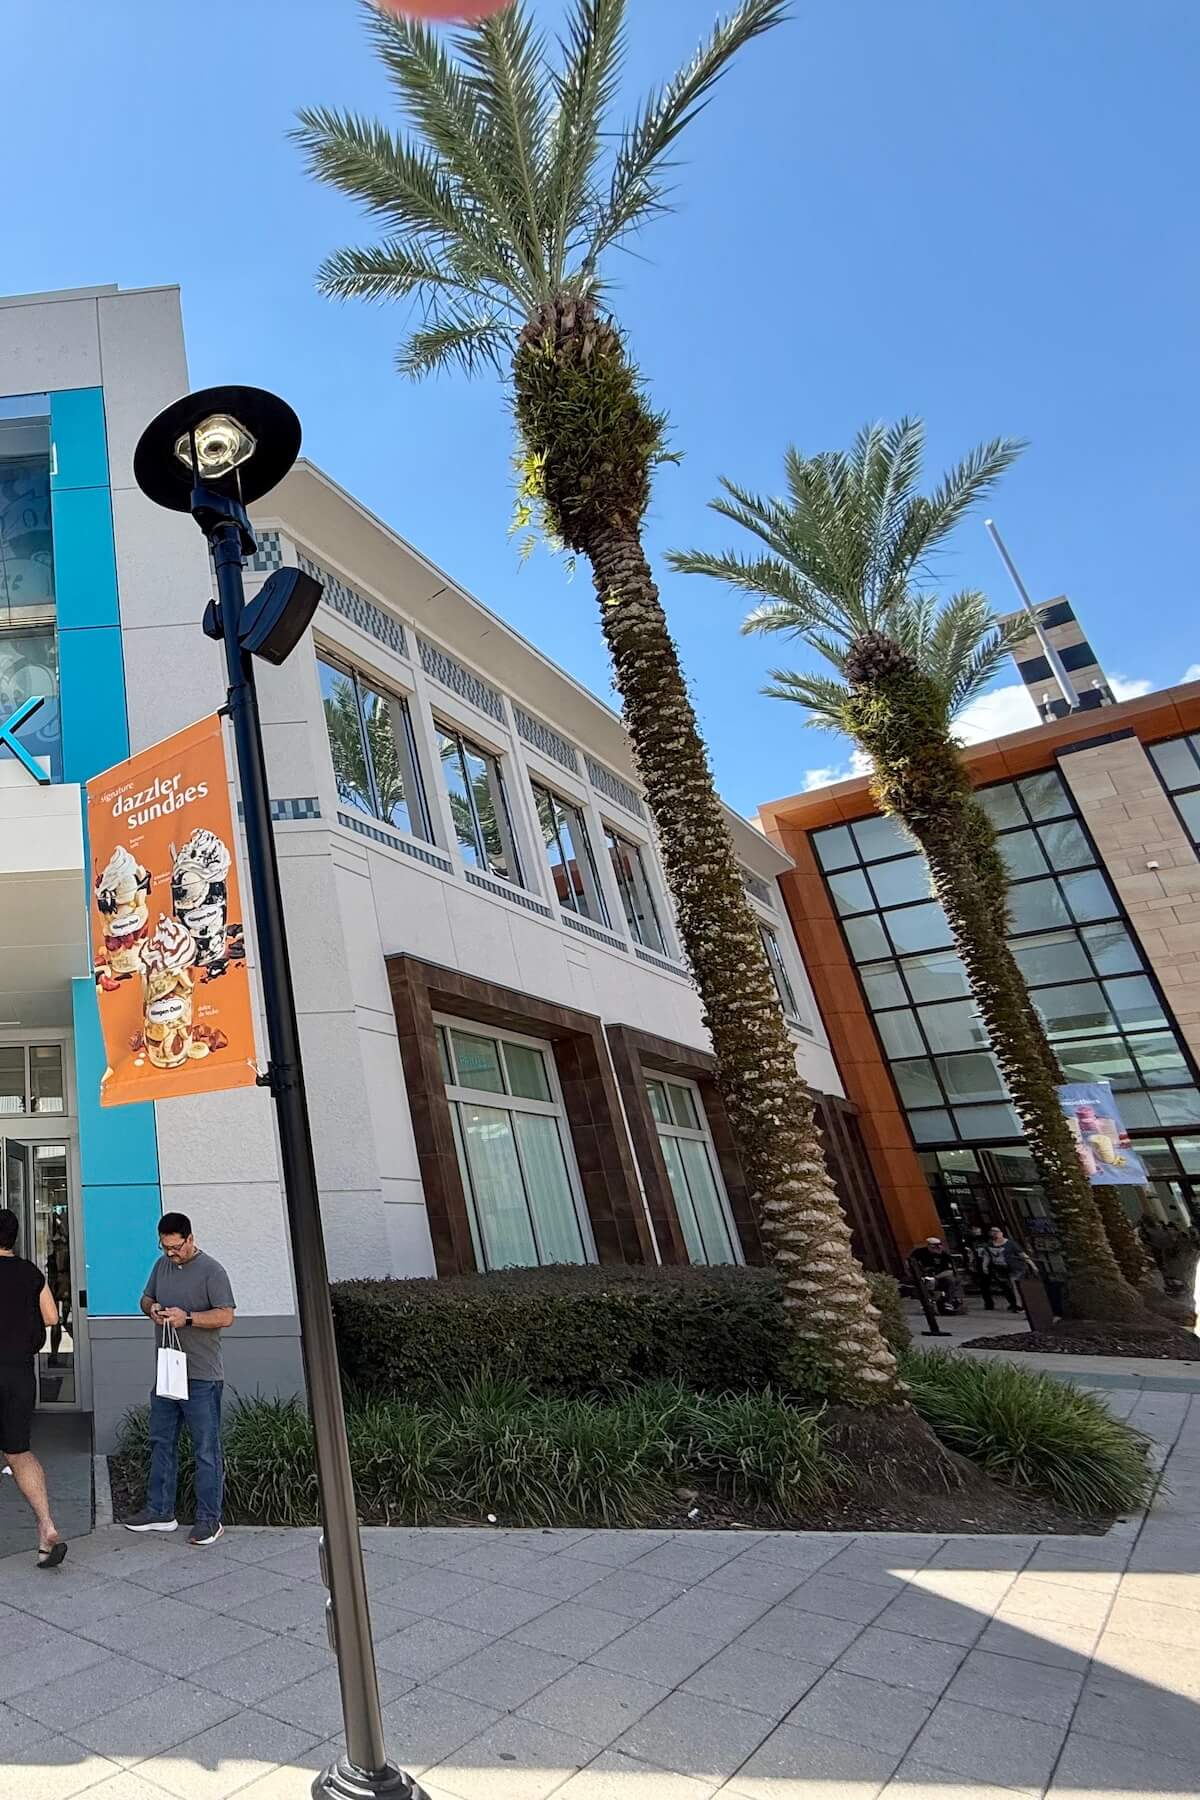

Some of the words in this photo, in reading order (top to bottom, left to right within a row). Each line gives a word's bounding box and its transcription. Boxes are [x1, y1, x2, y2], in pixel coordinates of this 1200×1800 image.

[100, 782, 135, 803] signature
[112, 773, 181, 817] dazzler
[127, 781, 209, 830] sundaes
